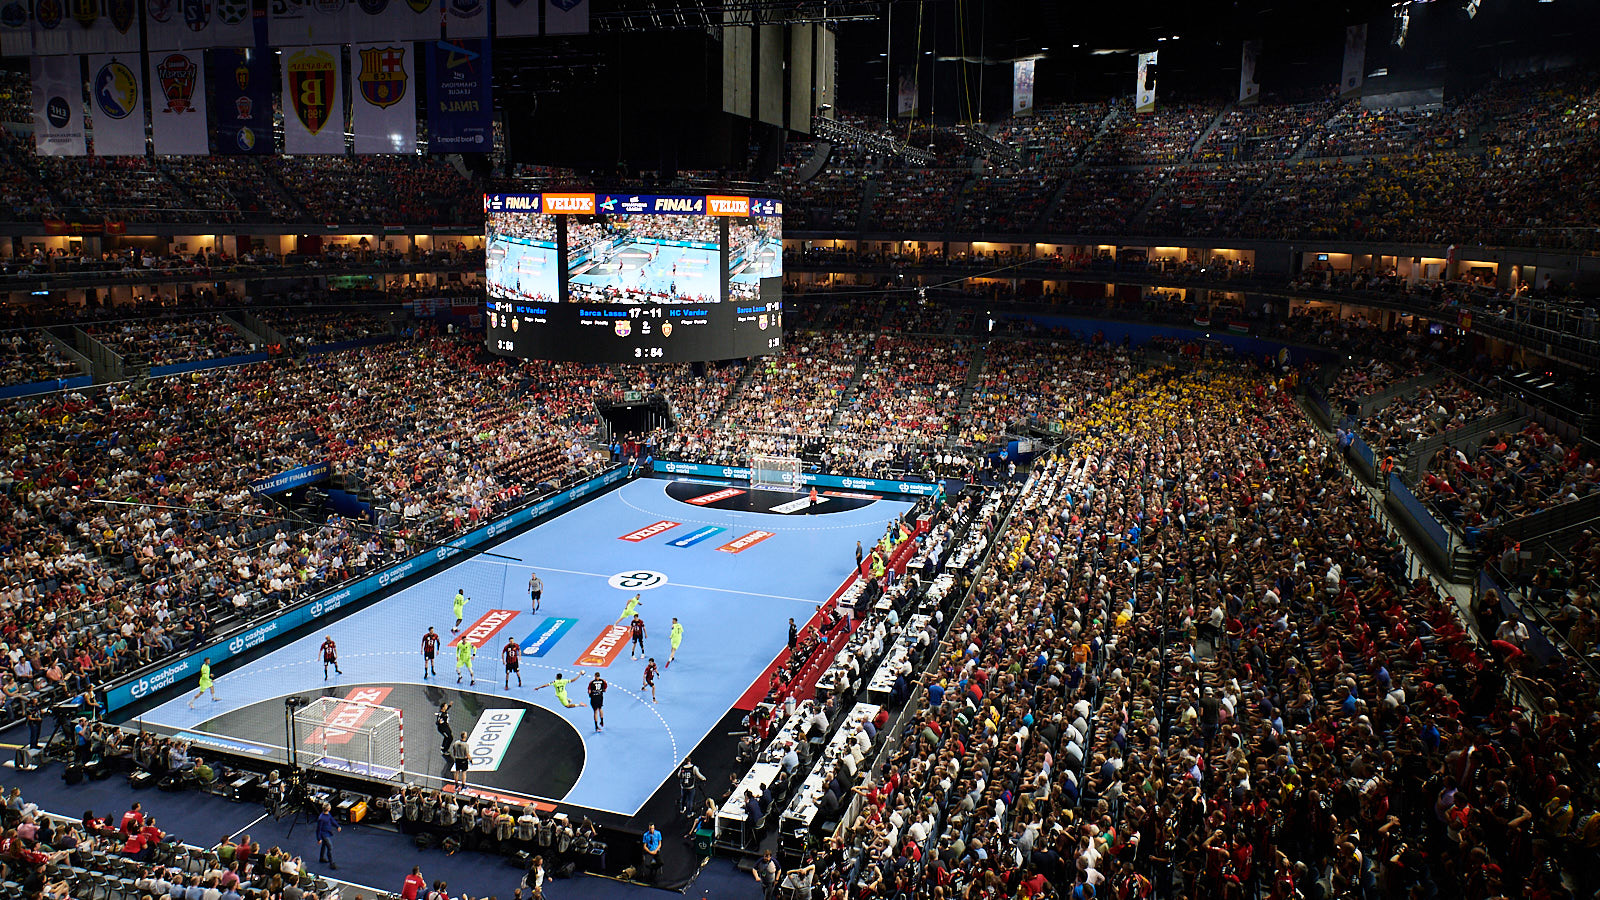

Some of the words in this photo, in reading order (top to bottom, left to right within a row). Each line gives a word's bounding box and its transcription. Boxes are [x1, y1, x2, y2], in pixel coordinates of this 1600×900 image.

[545, 197, 591, 210] VELUX
[654, 198, 703, 212] FINAL4
[710, 200, 747, 213] VELUX
[516, 305, 525, 313] HC
[526, 306, 547, 315] Vardar
[604, 309, 627, 317] Lassa
[683, 308, 708, 316] Vardar
[642, 321, 651, 329] 2
[253, 481, 275, 493] VELUX
[276, 477, 289, 486] EHF
[289, 471, 312, 482] FINAL4
[625, 521, 671, 540] VELUX
[730, 531, 768, 549] BETANO
[389, 562, 413, 576] cashback
[378, 572, 389, 584] cb
[390, 572, 405, 582] world
[323, 589, 351, 607] cashback
[310, 602, 323, 615] cb
[323, 600, 341, 613] world
[245, 622, 278, 641] cashback
[465, 611, 512, 644] VELUX
[229, 636, 244, 651] cb
[245, 634, 265, 648] world
[590, 625, 628, 657] BETANO
[149, 661, 189, 684] cashback
[130, 679, 149, 695] cb
[150, 675, 175, 692] world
[470, 713, 510, 766] gorenje
